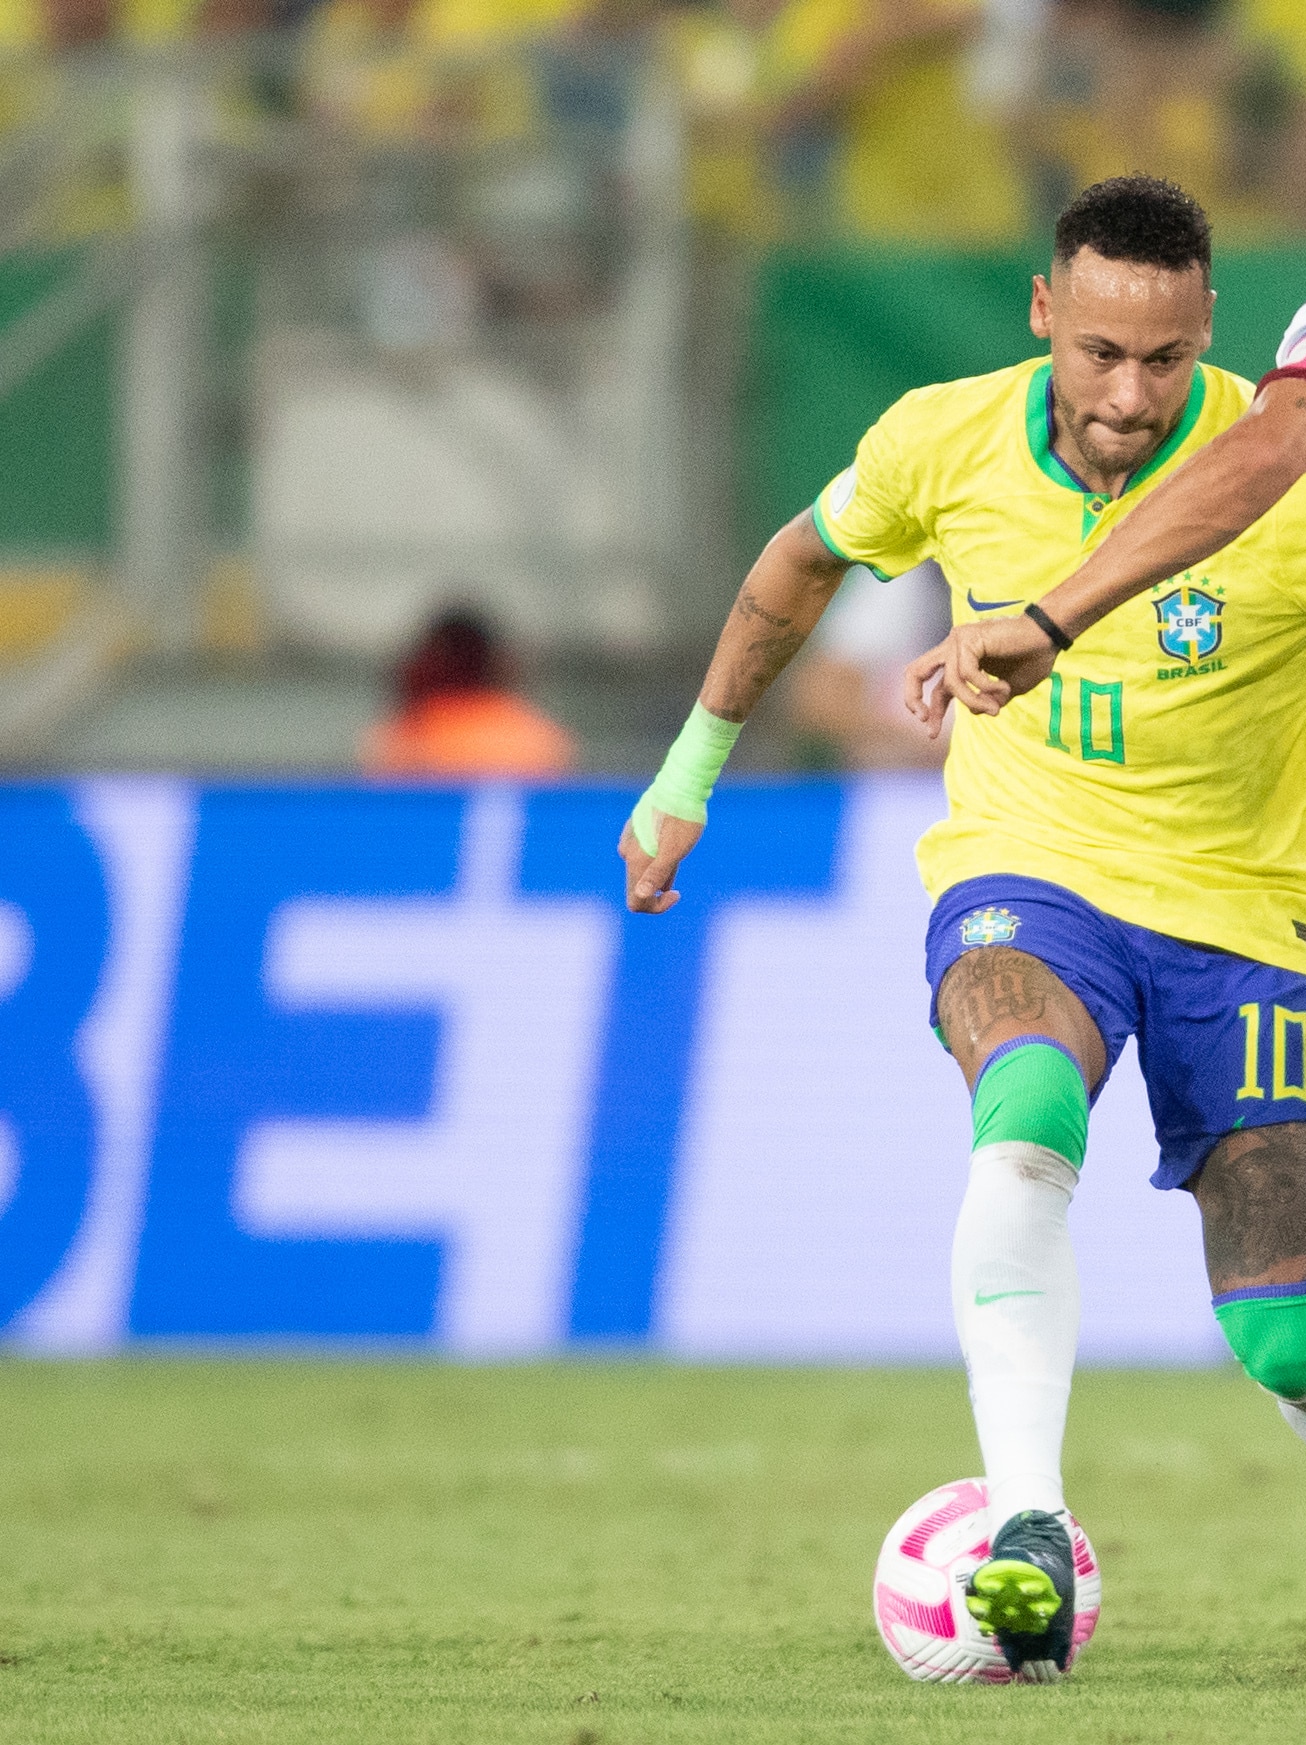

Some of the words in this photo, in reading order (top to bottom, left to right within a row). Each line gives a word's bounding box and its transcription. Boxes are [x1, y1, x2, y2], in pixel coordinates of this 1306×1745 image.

[1176, 618, 1202, 627] CBF
[1157, 660, 1228, 680] BRASIL
[1045, 671, 1126, 765] 10
